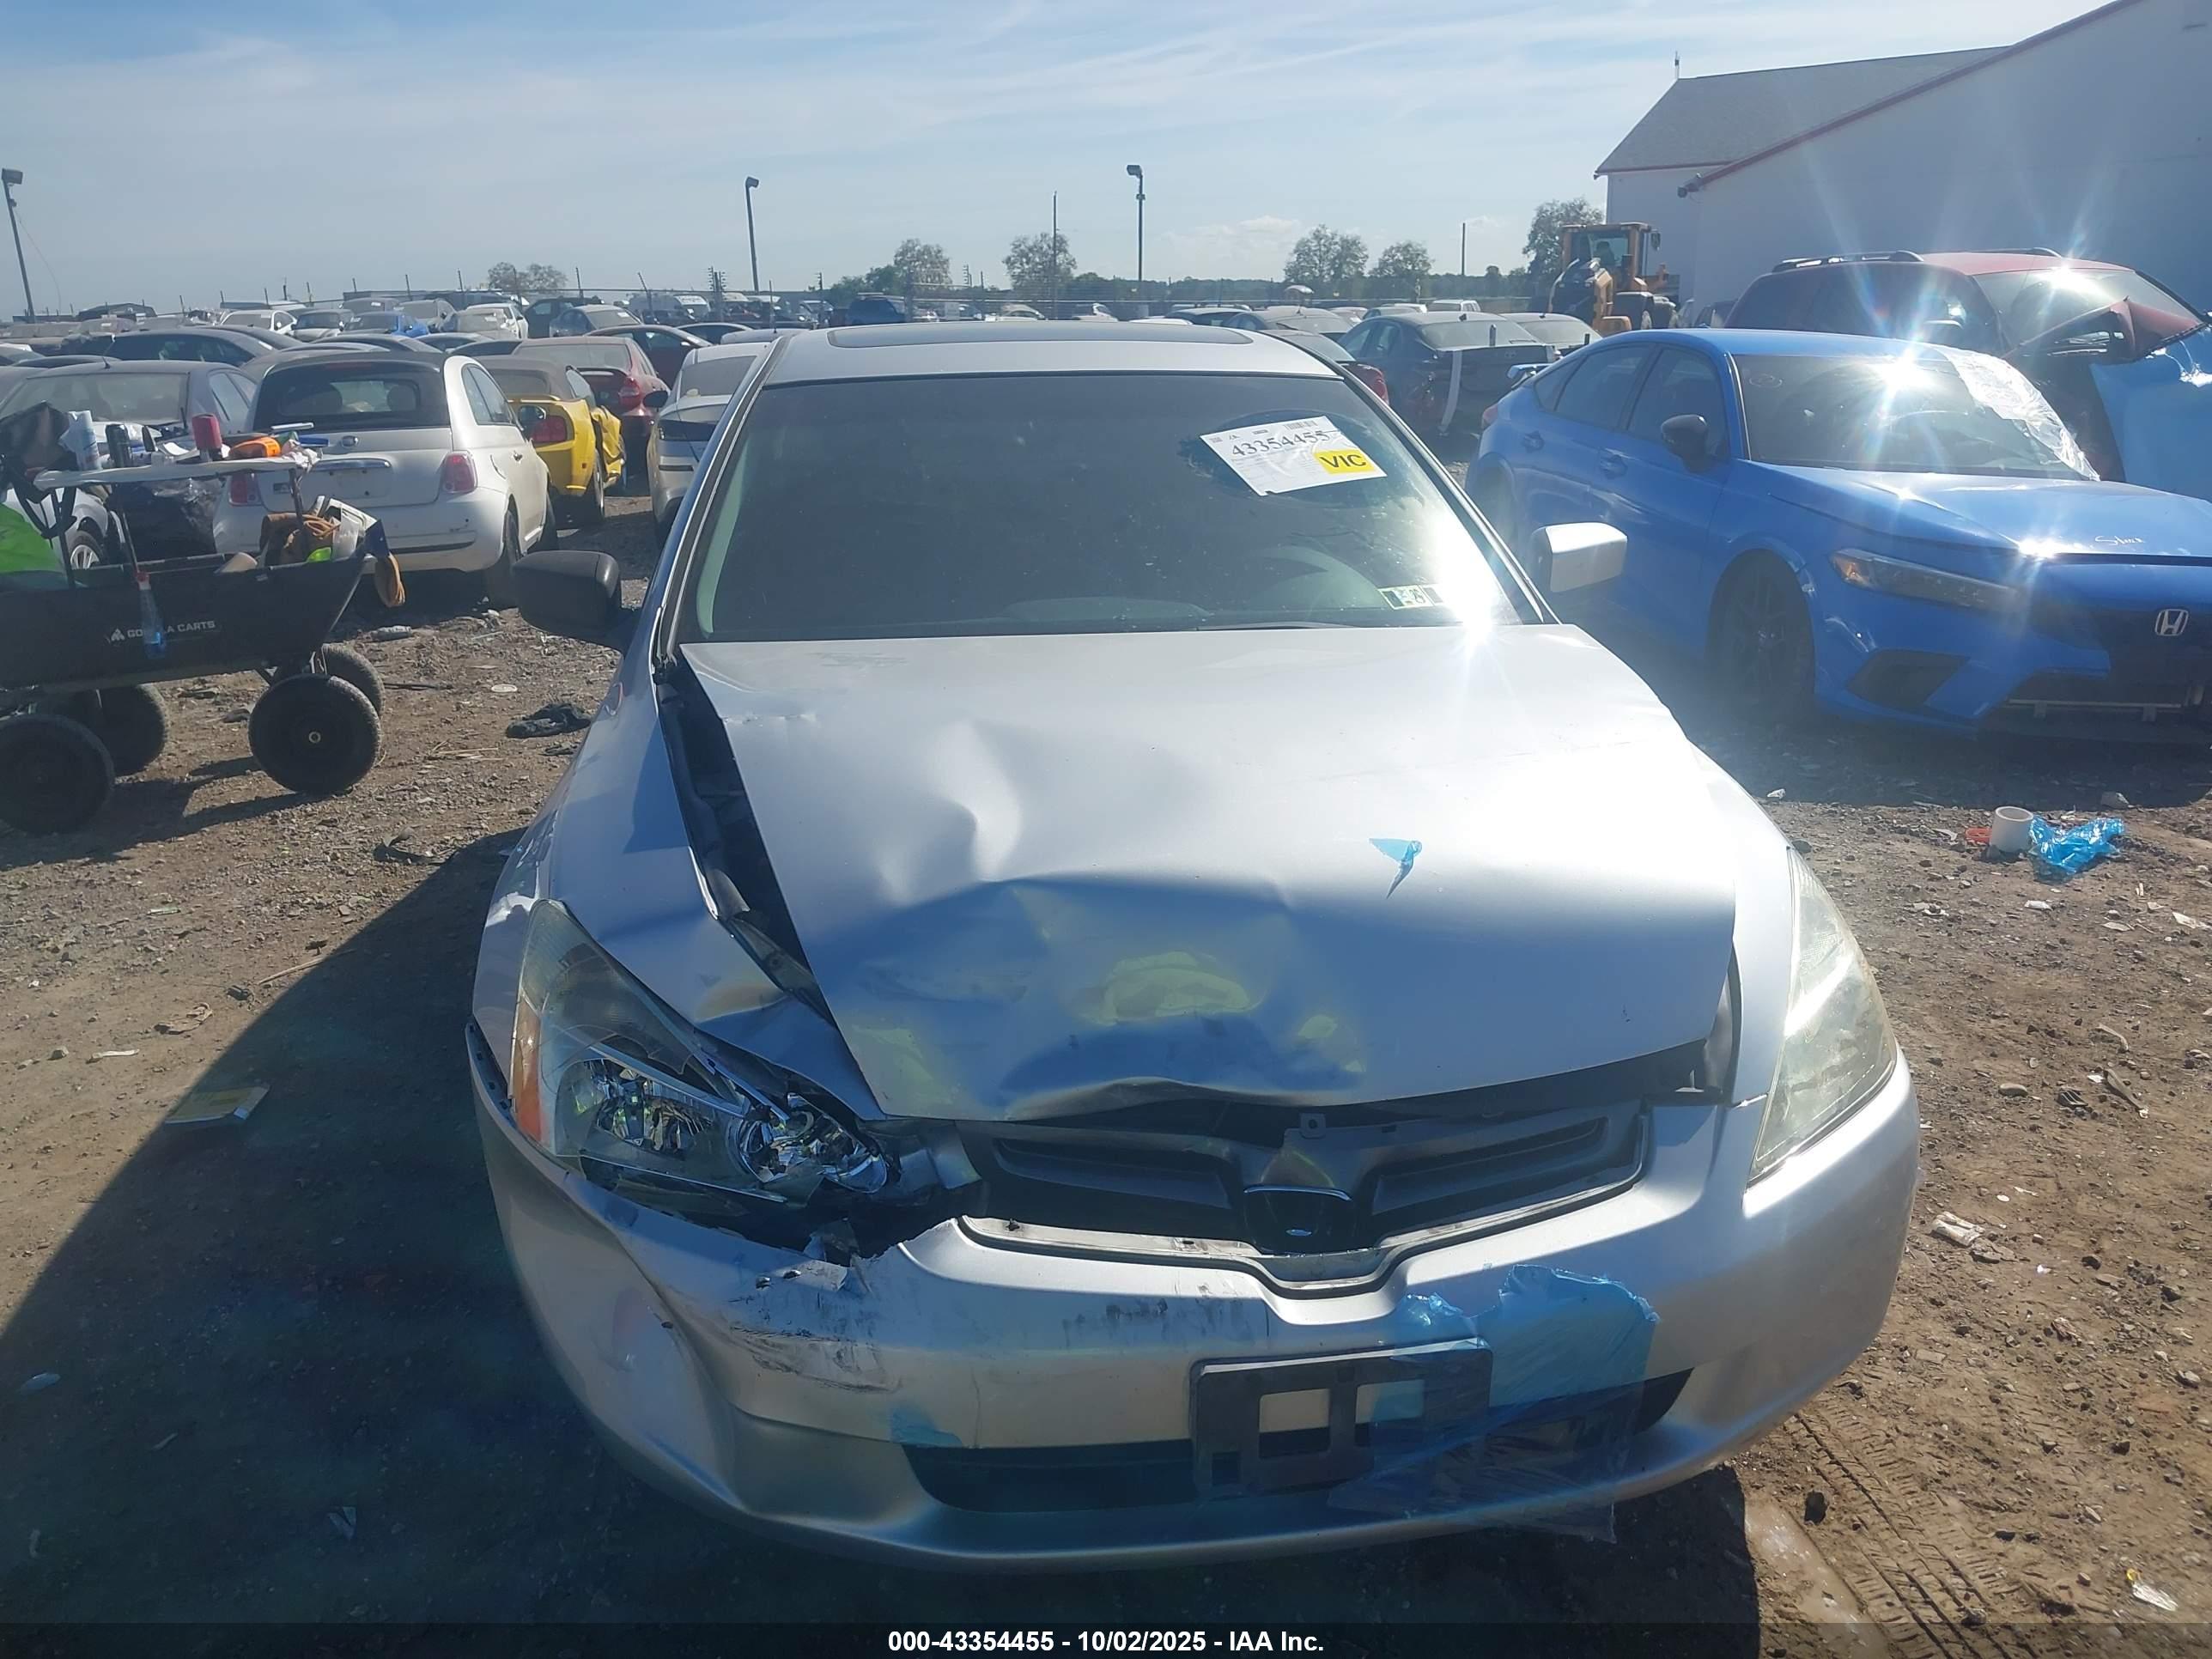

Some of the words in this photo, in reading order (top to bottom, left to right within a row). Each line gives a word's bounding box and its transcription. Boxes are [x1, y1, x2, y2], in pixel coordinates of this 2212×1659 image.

[1231, 430, 1330, 457] 43354455
[1320, 453, 1367, 469] VIC
[177, 620, 216, 632] CARTS
